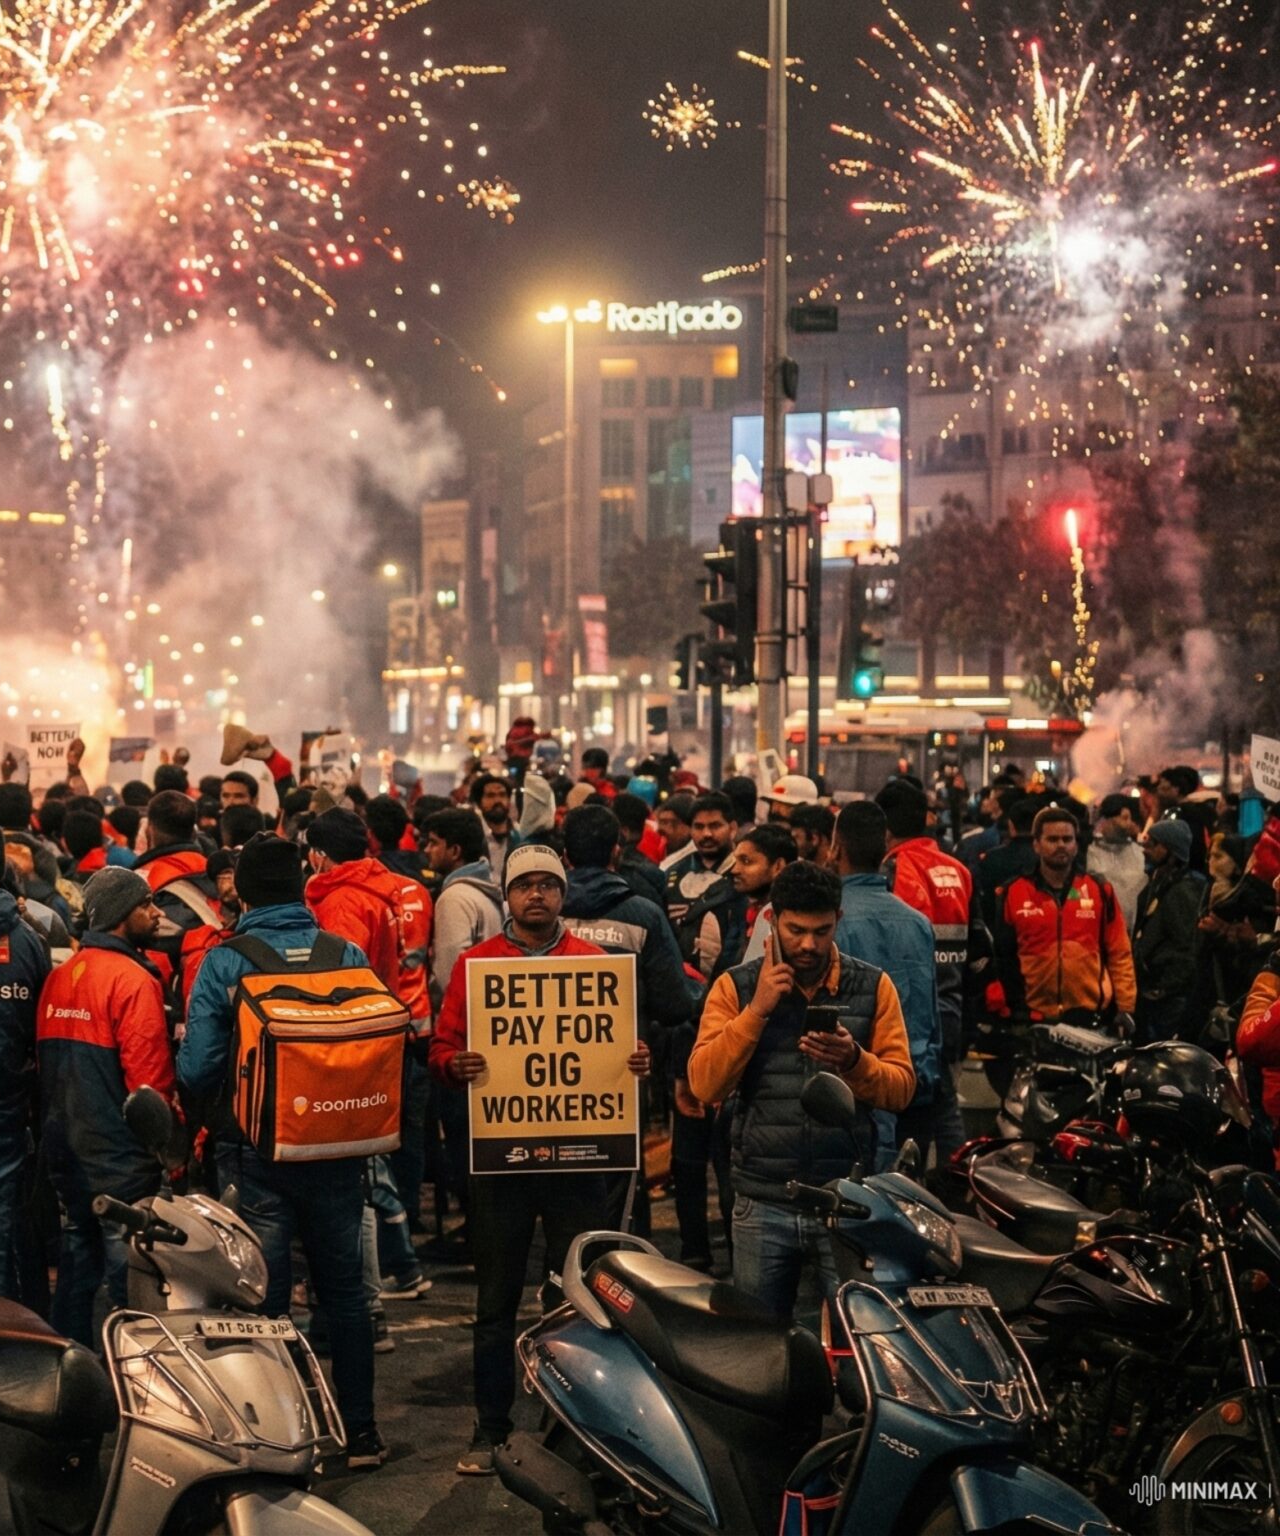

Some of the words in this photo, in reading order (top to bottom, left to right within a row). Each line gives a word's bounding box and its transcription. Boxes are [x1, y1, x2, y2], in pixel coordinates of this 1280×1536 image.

[484, 971, 619, 1009] BETTER
[491, 1015, 545, 1046] PAY
[556, 1014, 614, 1044] FOR
[525, 1052, 581, 1088] GIG
[481, 1093, 624, 1124] WORKERS!
